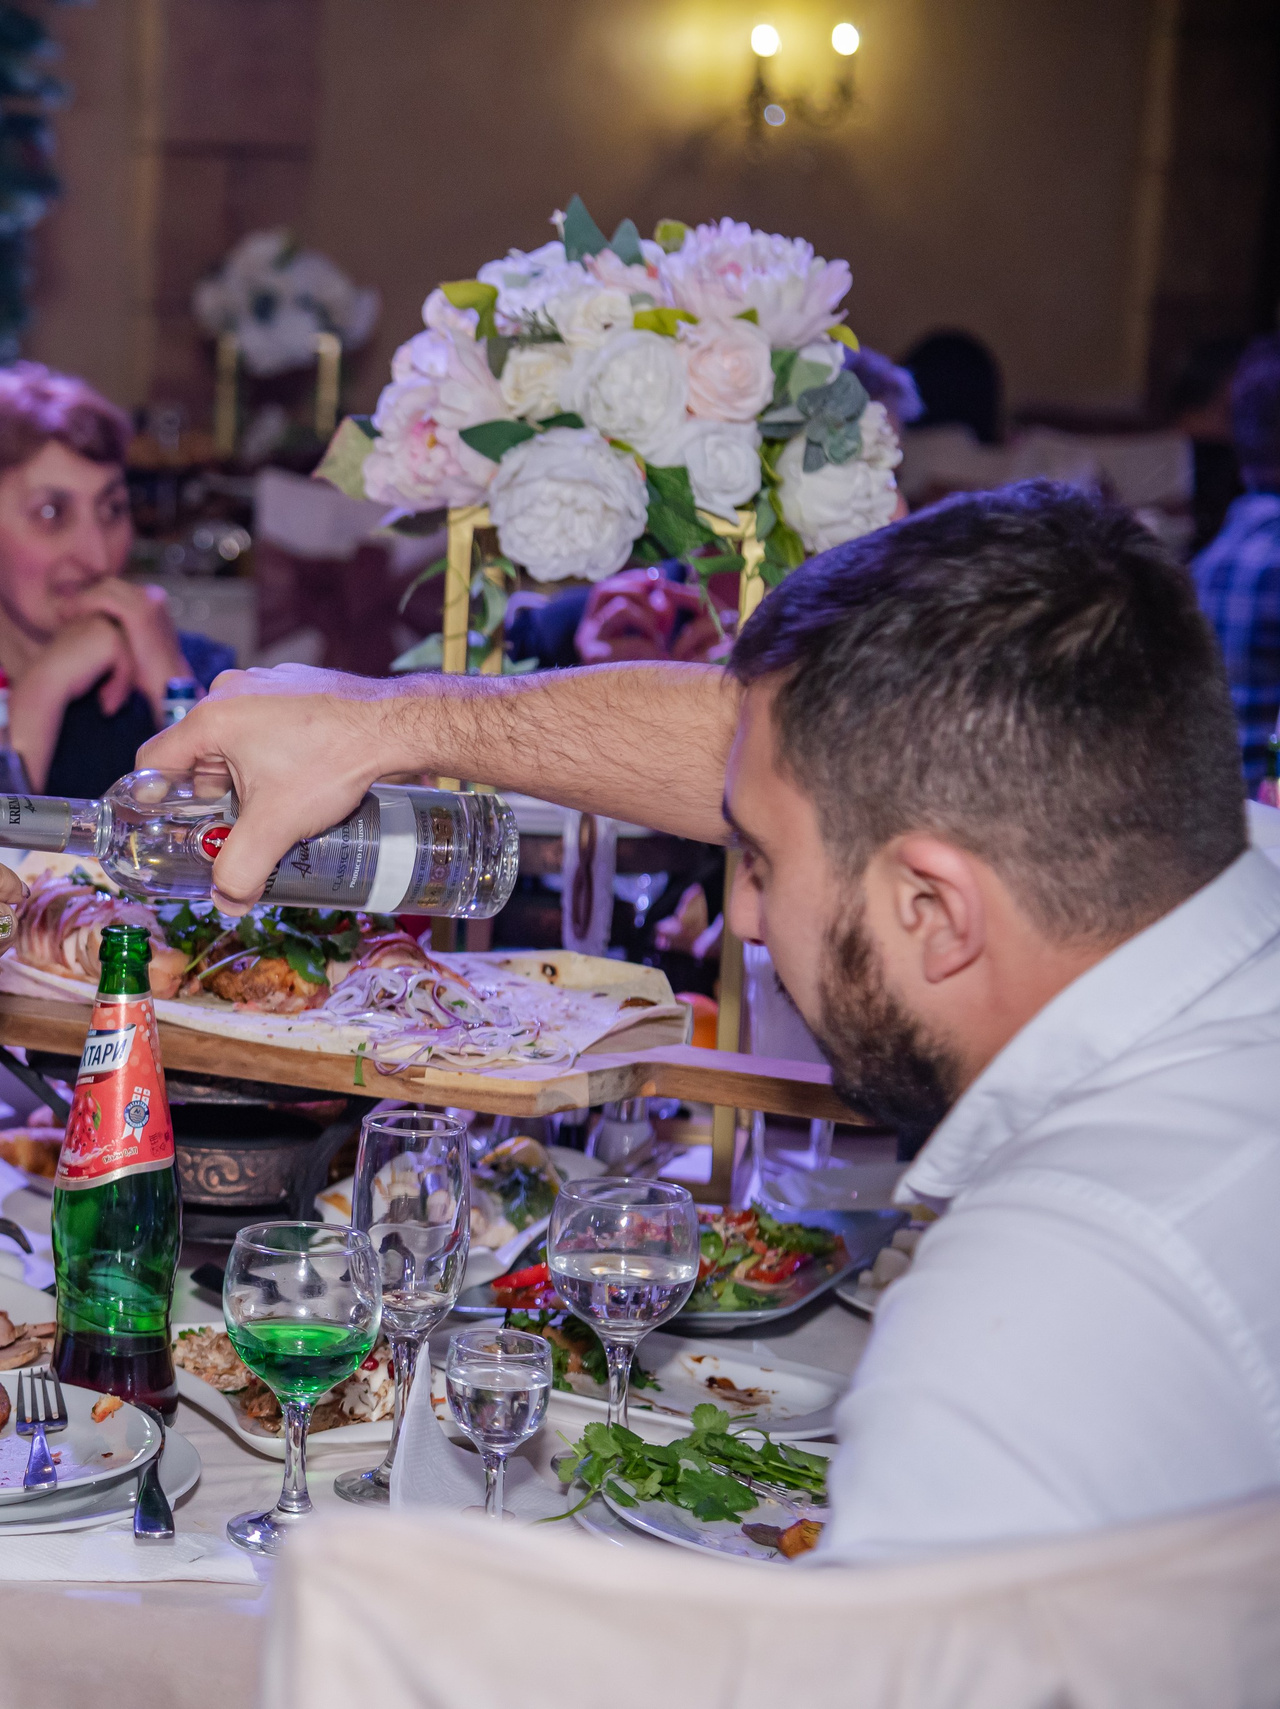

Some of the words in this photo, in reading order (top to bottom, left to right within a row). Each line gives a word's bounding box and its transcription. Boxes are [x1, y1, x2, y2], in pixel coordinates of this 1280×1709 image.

[291, 839, 312, 878] Awa
[332, 852, 350, 892] CLASSIC
[349, 854, 362, 888] PRODUCED
